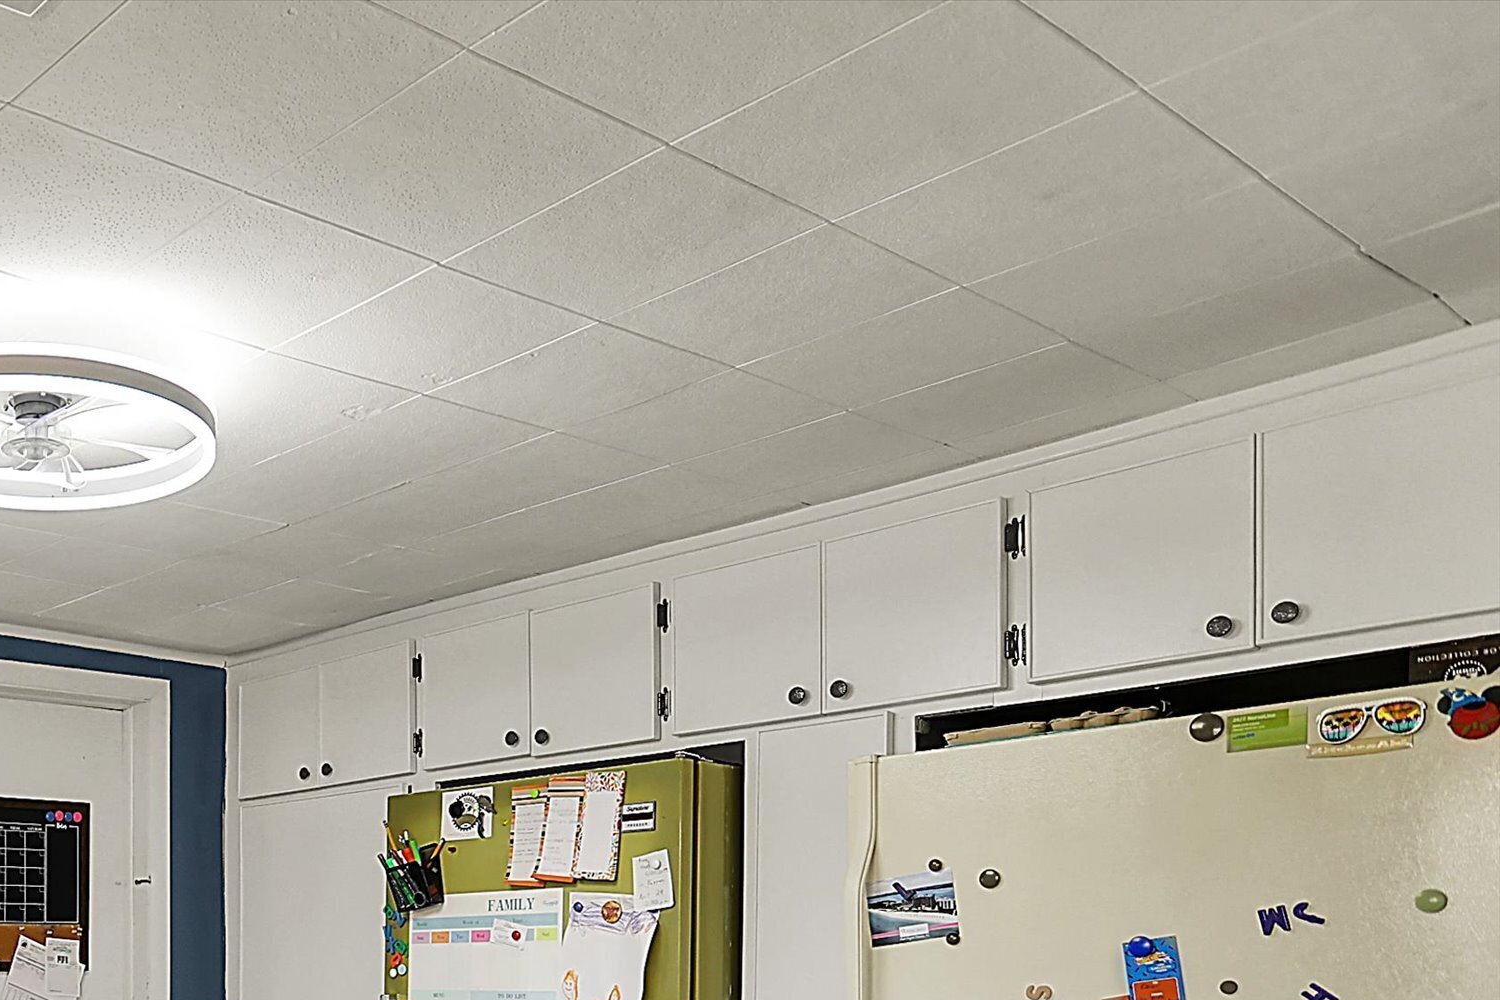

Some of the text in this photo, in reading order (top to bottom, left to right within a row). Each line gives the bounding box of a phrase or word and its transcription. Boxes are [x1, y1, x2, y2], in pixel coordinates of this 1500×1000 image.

[1417, 646, 1500, 663] OR COLLECTION
[488, 897, 535, 912] FAMILY
